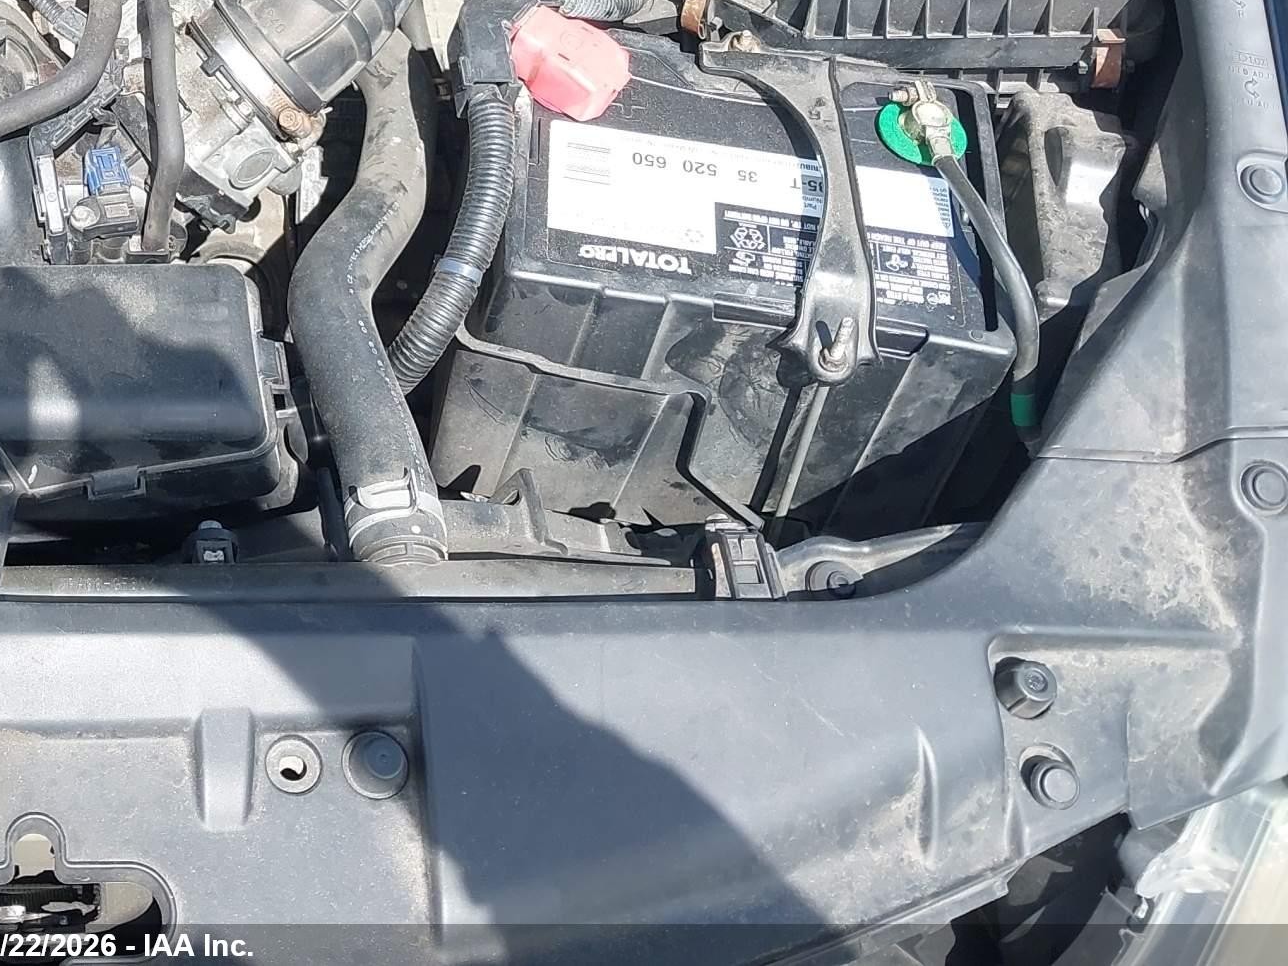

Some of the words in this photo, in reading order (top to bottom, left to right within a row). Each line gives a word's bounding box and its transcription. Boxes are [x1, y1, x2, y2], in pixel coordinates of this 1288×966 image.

[632, 152, 667, 168] 650
[683, 160, 717, 177] 520
[738, 169, 757, 182] 35
[577, 243, 693, 275] TOTALPRO
